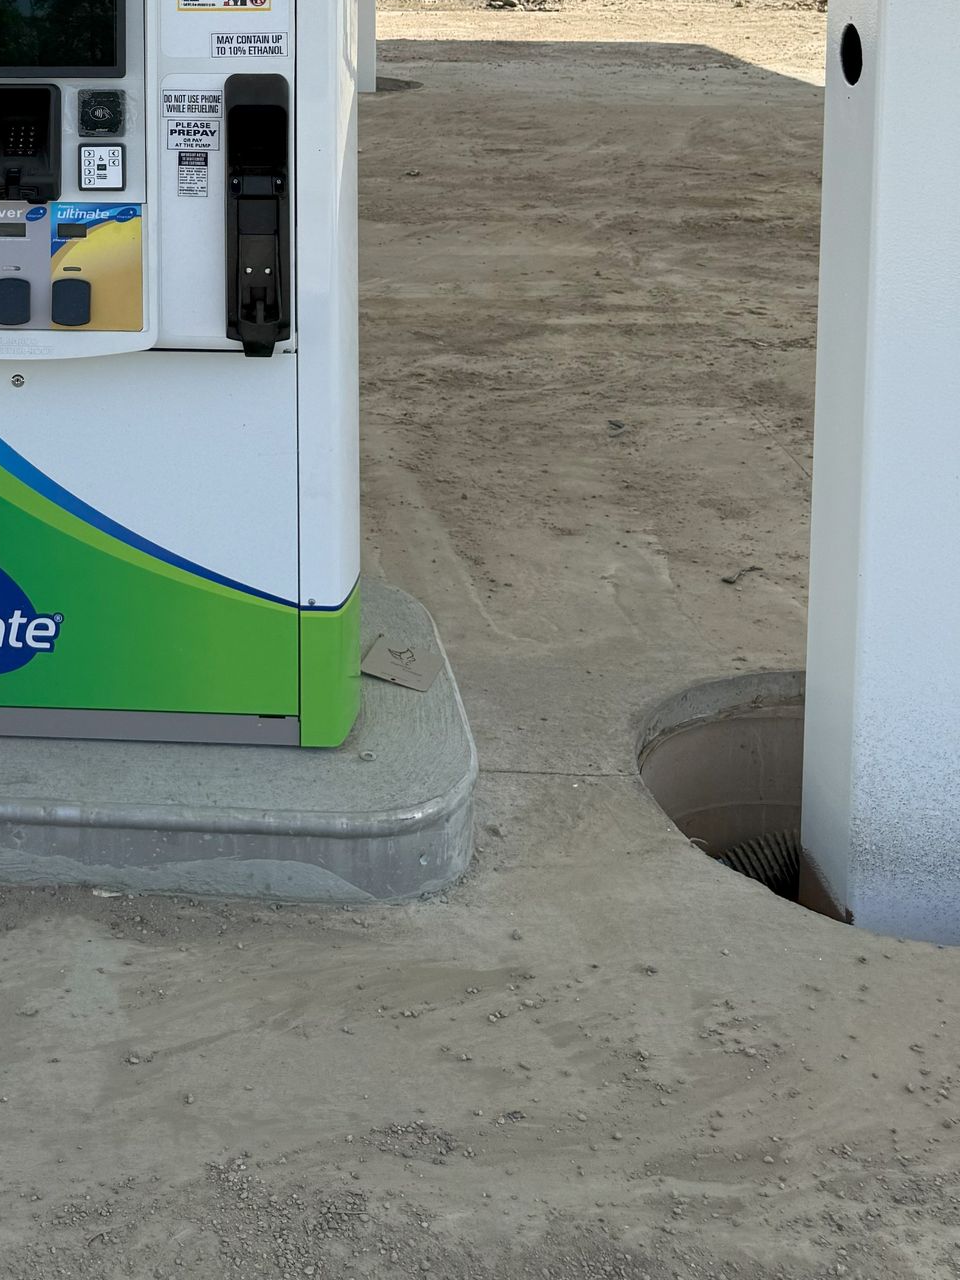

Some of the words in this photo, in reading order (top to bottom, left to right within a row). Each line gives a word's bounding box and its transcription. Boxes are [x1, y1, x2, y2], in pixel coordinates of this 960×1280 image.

[216, 35, 235, 44] MAY
[236, 35, 270, 44] CONTAIN
[272, 34, 282, 44] UP
[216, 46, 226, 55] TO
[229, 46, 246, 55] 10%
[248, 46, 284, 55] ETHANOL
[164, 95, 173, 103] DO
[174, 95, 186, 103] NOT
[188, 95, 200, 103] USE
[200, 95, 222, 104] PHONE
[167, 105, 186, 113] WHILE
[187, 105, 219, 113] REFUELING
[57, 208, 110, 219] ultimate
